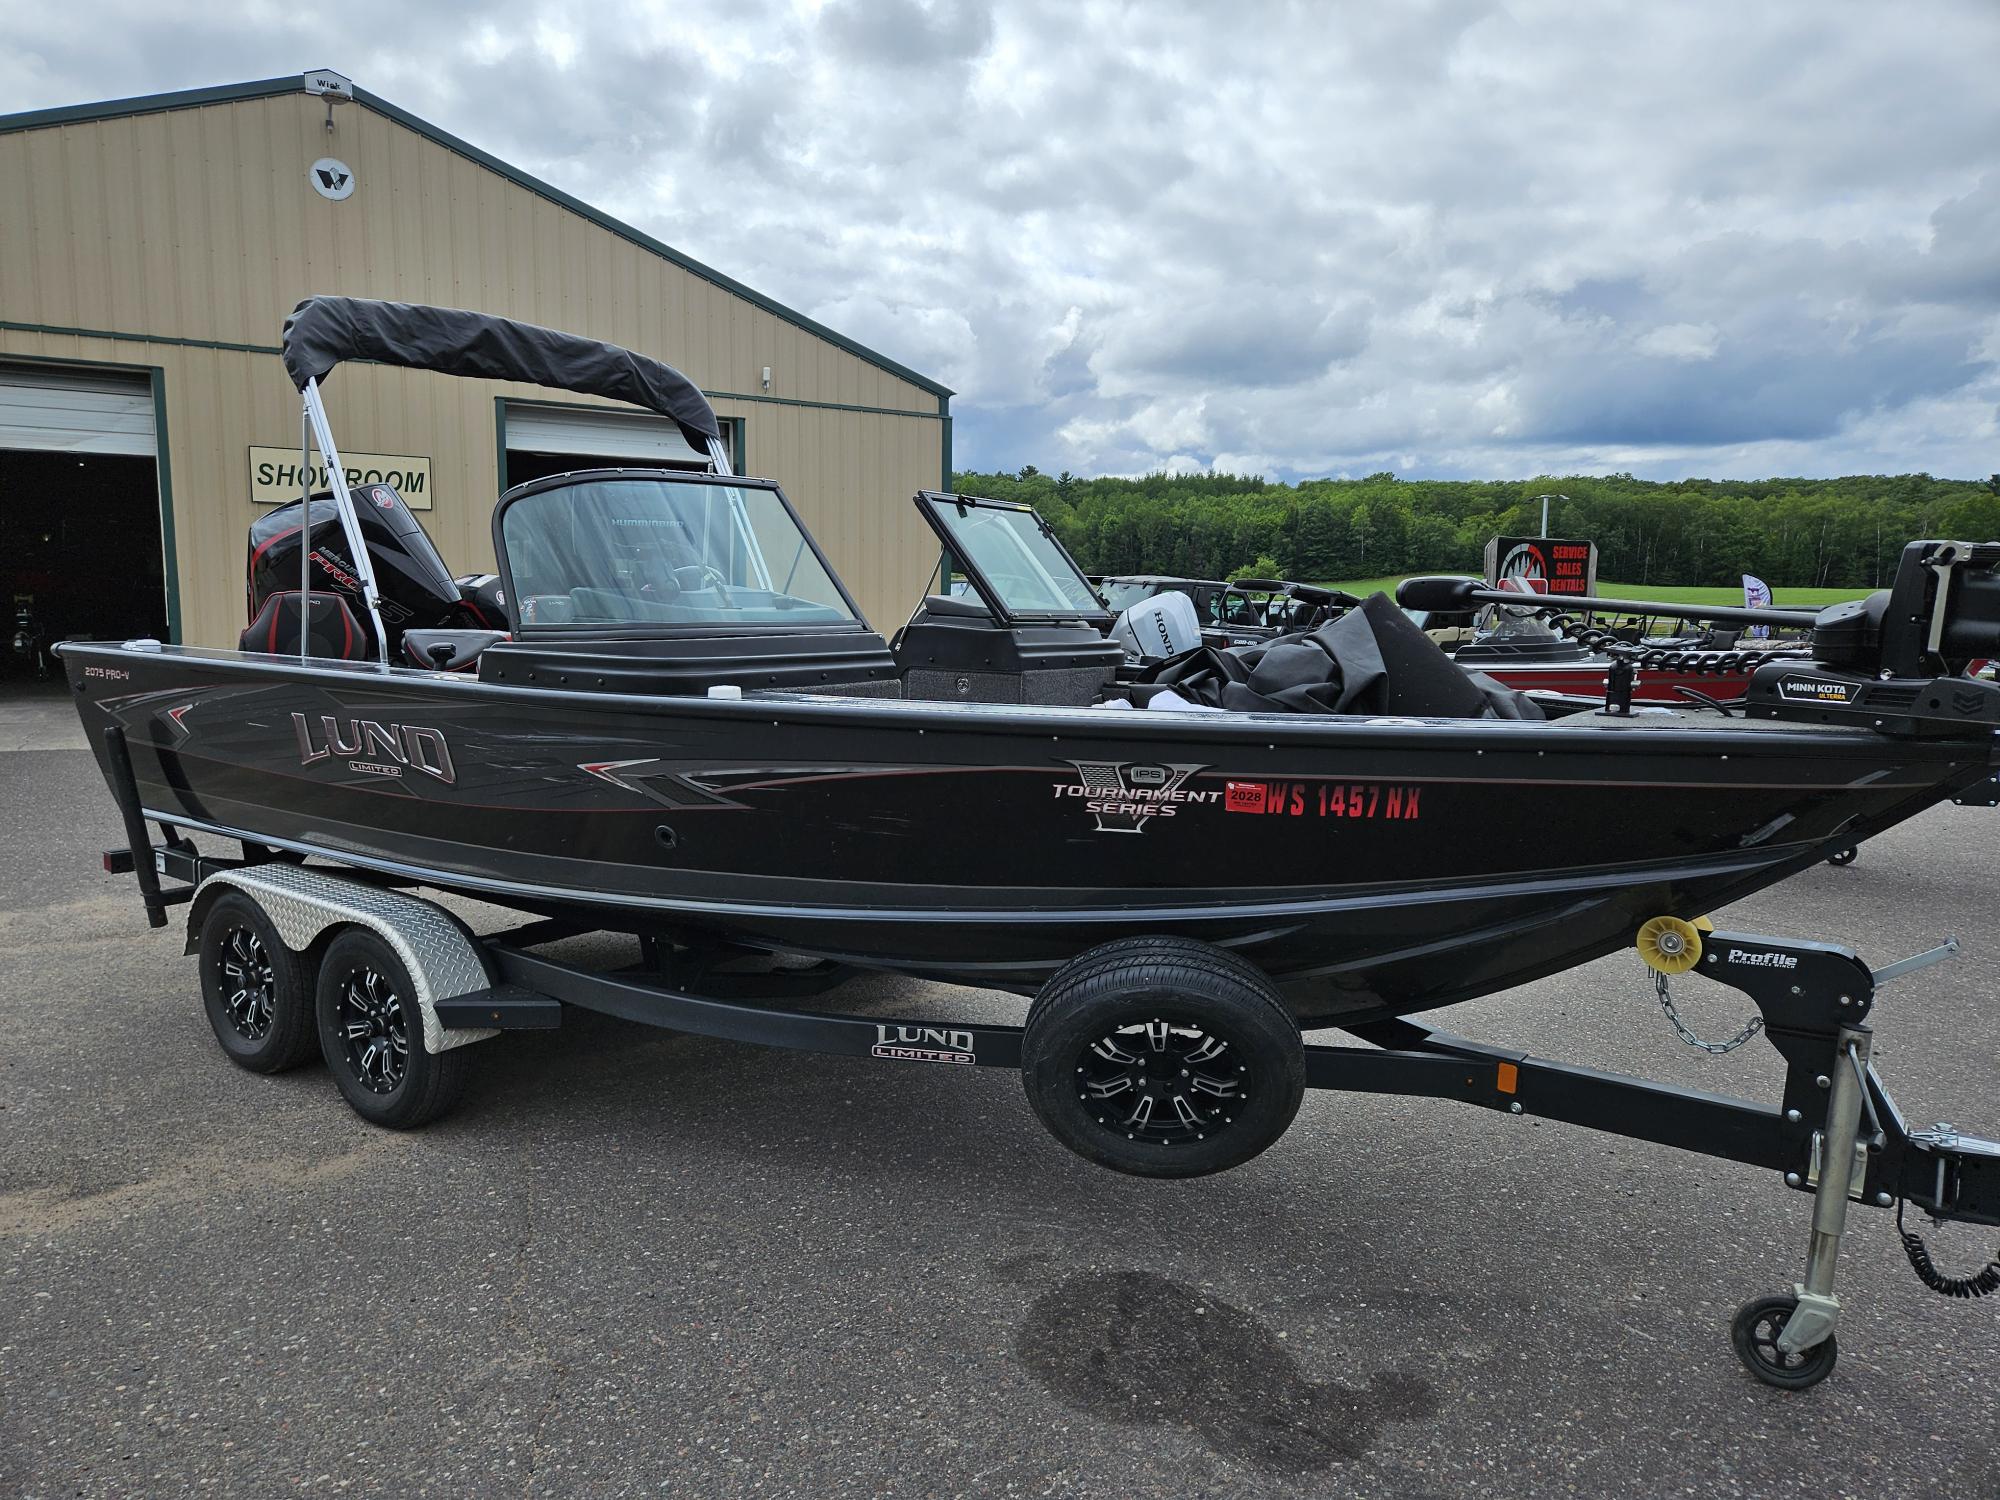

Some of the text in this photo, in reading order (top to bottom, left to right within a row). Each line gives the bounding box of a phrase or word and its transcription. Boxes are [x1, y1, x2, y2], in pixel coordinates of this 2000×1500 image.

[1553, 545, 1588, 559] SERVICE
[1556, 562, 1582, 576] SALES
[1550, 578, 1585, 592] RENTALS
[1153, 610, 1175, 657] HOND
[85, 666, 130, 680] 2075 PRO-V
[1786, 682, 1847, 695] MINN KOTA
[291, 712, 457, 783] LUND
[351, 763, 400, 775] LIMITED
[1136, 770, 1161, 778] IPS
[1053, 784, 1224, 803] TOURNAMENT
[1231, 790, 1262, 802] 2028
[1267, 782, 1421, 819] WS 1457 NX
[1085, 801, 1178, 816] SERIES
[1728, 949, 1798, 966] Profile
[1728, 959, 1771, 967] PERFORMANCE
[876, 1024, 974, 1053] LUND
[876, 1047, 971, 1063] LIMITED
